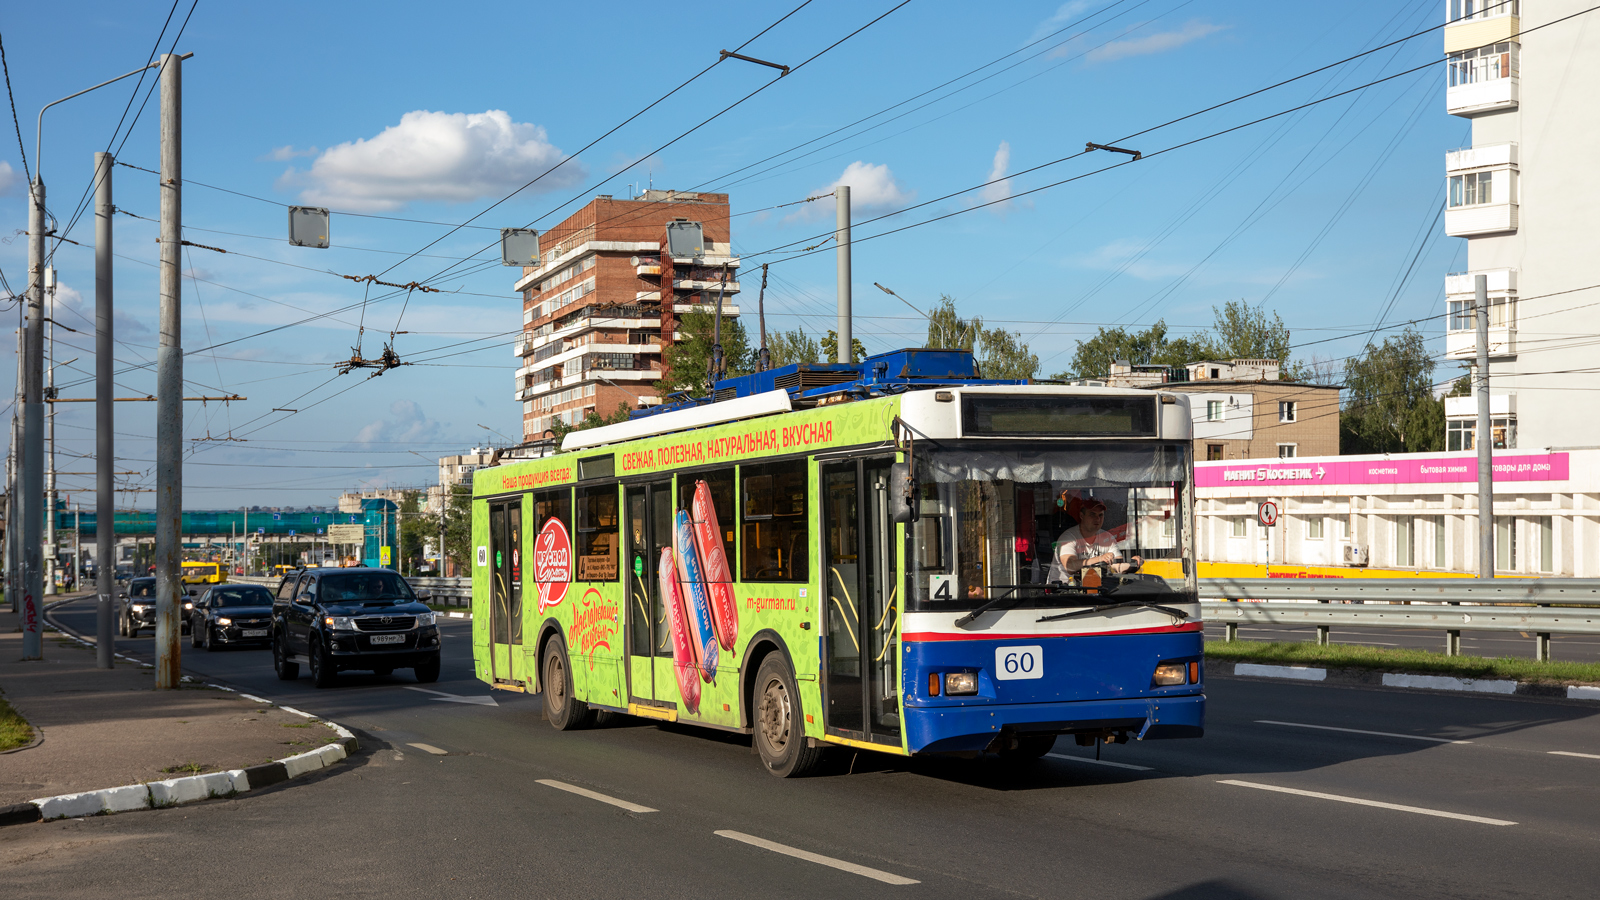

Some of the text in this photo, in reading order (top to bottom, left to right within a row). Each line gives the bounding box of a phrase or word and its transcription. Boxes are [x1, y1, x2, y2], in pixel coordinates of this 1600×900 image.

[622, 420, 832, 470] СВЕЖАЯ, ПОЛЕЗНАЯ, НАТУРАЛЬНАЯ, ВКУСНАЯ
[1224, 468, 1314, 481] МАГНИТ КОСМЕТИК
[1420, 465, 1446, 474] бытовая
[1518, 464, 1531, 472] для
[1532, 463, 1550, 472] дома
[502, 468, 572, 490] Наша продукция всегда:
[478, 550, 486, 562] 60
[580, 558, 586, 578] 4
[690, 557, 709, 630] МОЛОЧНАЯ
[934, 580, 952, 600] 4
[746, 598, 796, 613] m-gurman.ru
[1004, 652, 1034, 674] 60
